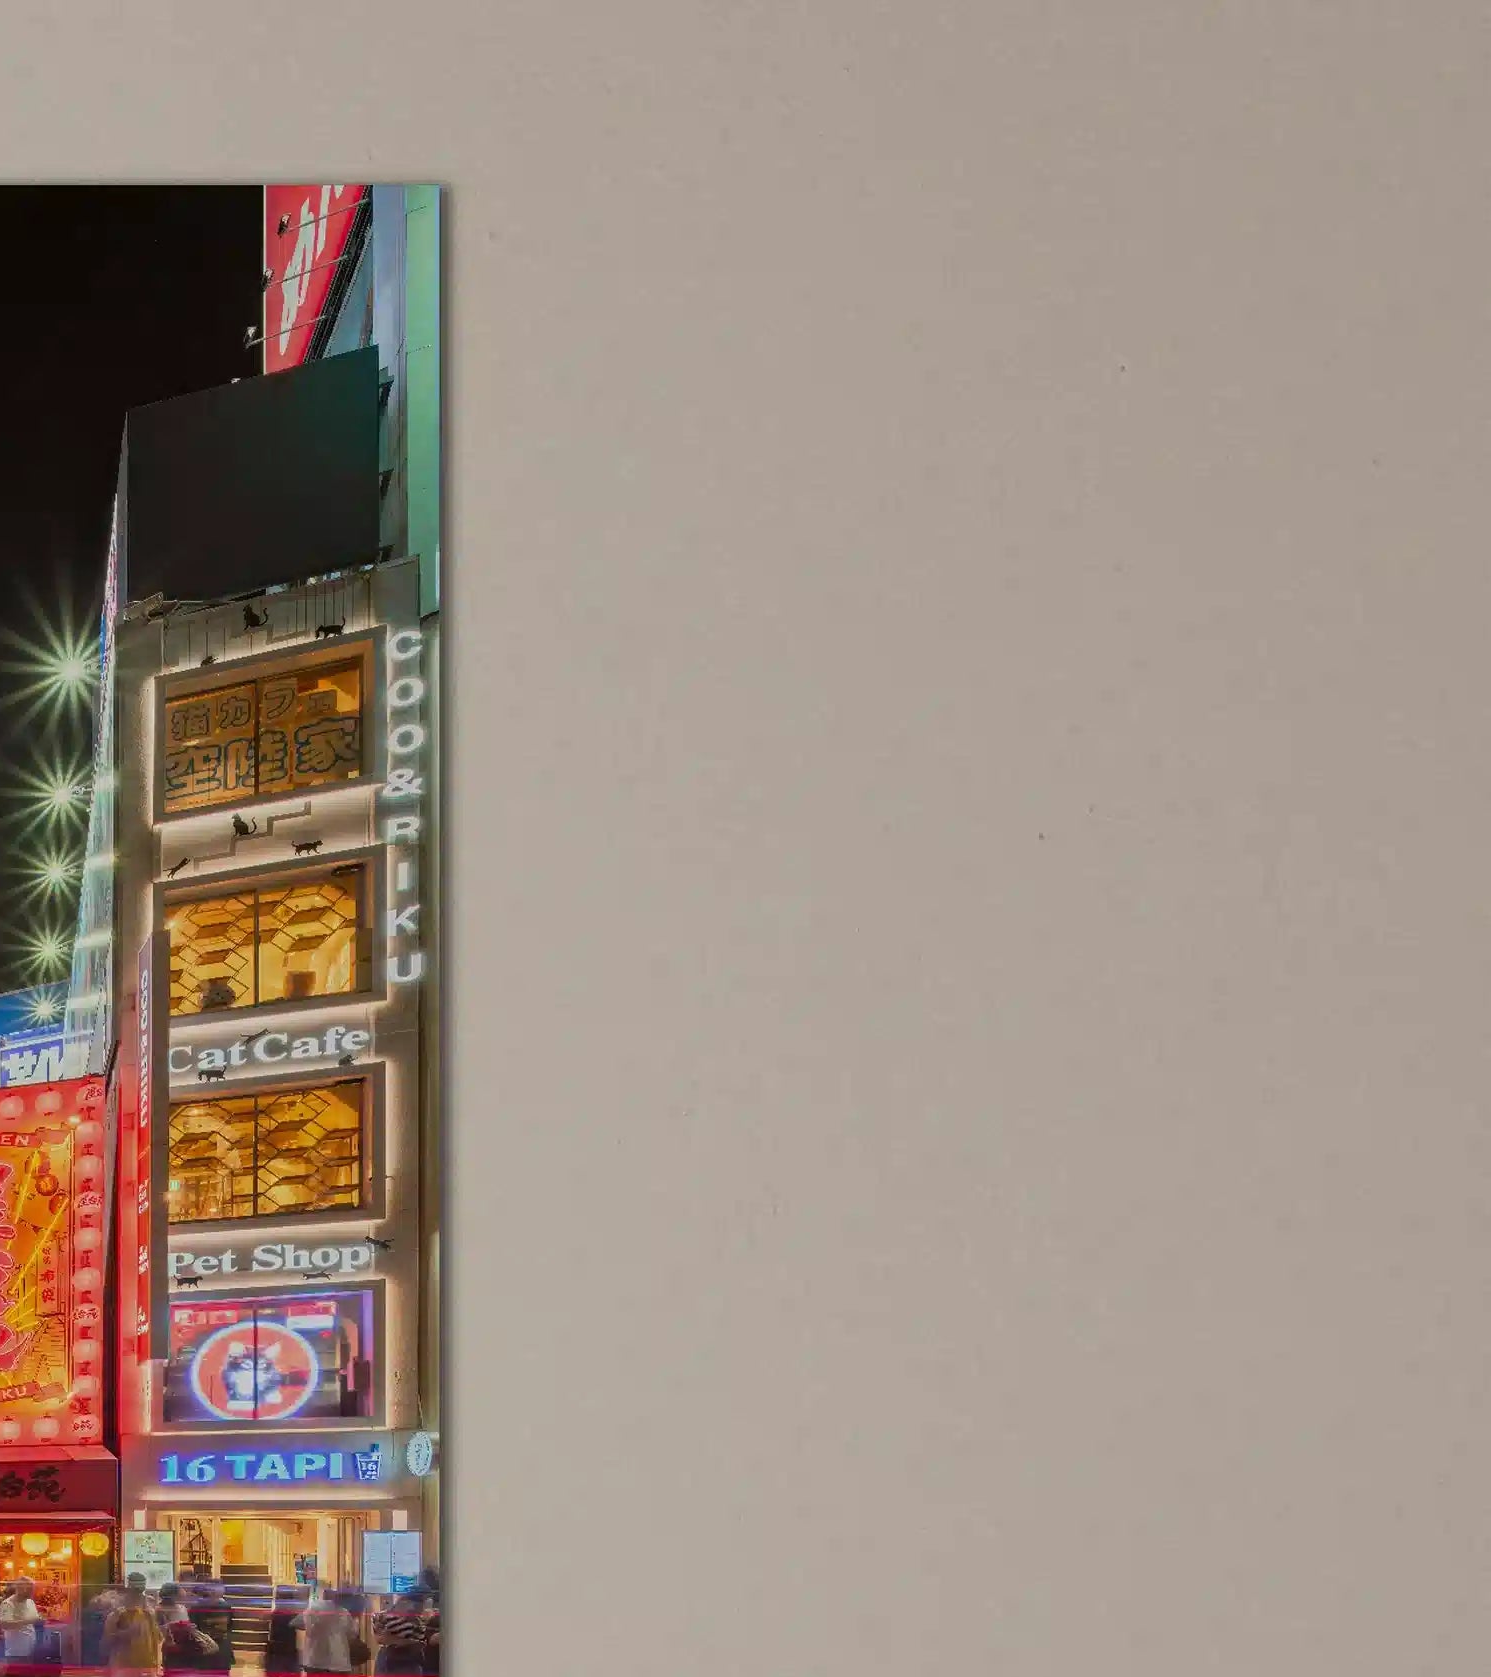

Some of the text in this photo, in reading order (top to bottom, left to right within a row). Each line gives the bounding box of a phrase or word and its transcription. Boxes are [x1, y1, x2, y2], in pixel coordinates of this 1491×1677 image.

[168, 1026, 369, 1073] Cat Cafe
[168, 1243, 370, 1277] Pet Shop
[160, 1453, 343, 1482] 16 TAPI
